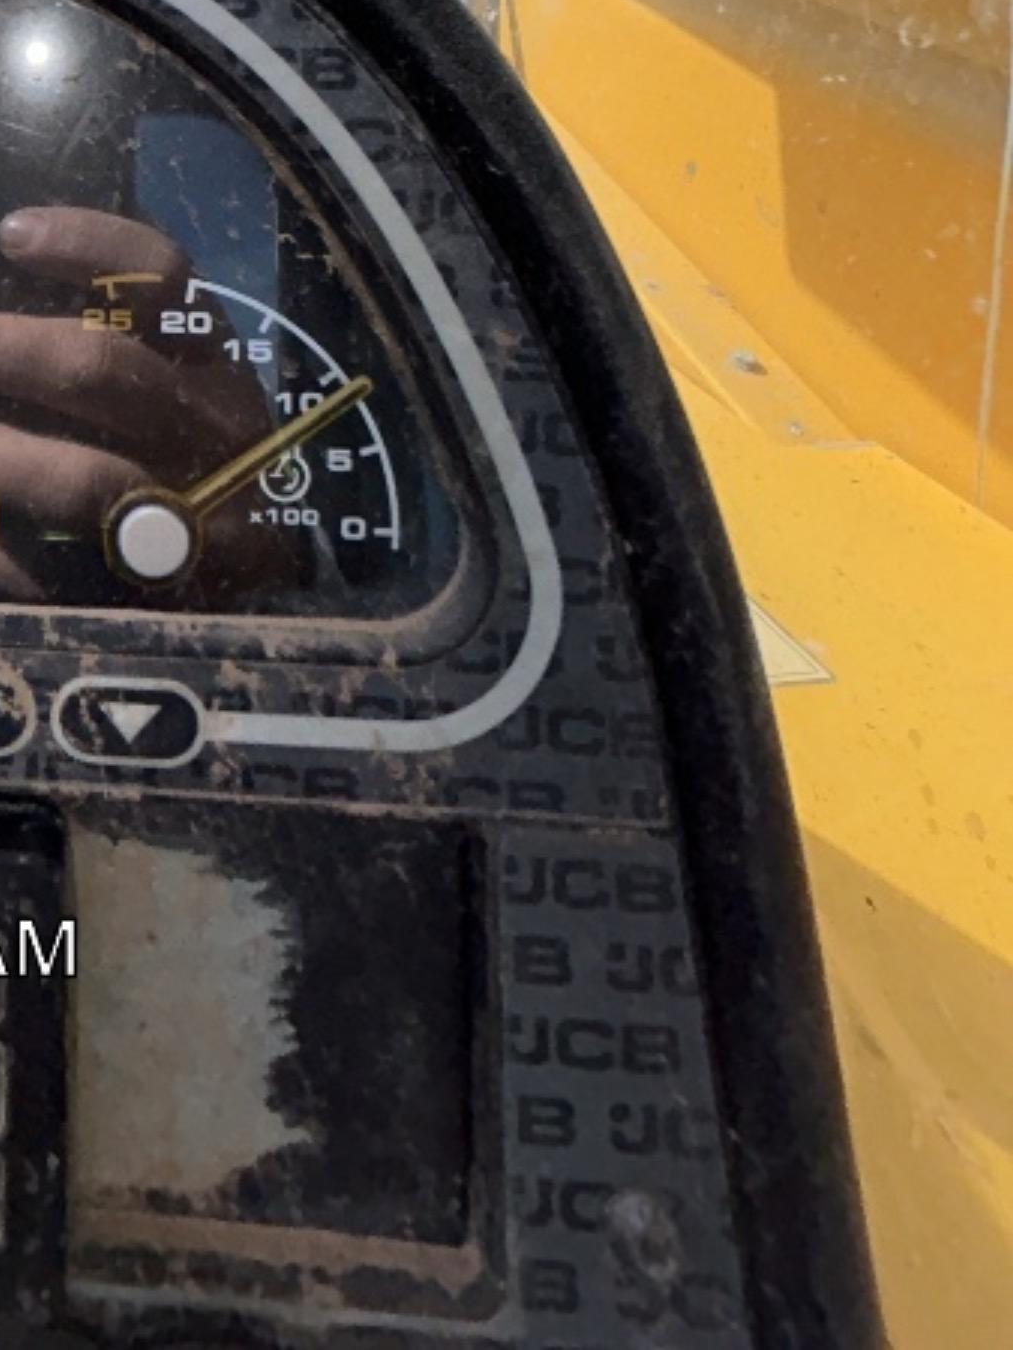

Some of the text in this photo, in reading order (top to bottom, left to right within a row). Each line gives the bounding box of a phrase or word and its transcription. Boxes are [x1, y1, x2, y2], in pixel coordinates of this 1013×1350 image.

[81, 308, 134, 332] 25
[159, 310, 214, 335] 20
[223, 338, 274, 363] 15
[275, 392, 324, 415] 10
[326, 448, 353, 473] 5
[248, 508, 321, 526] x100
[340, 516, 367, 541] 0
[503, 854, 678, 913] JCB
[605, 942, 699, 998] JC
[507, 1013, 683, 1075] JCB
[608, 1101, 714, 1159] JC
